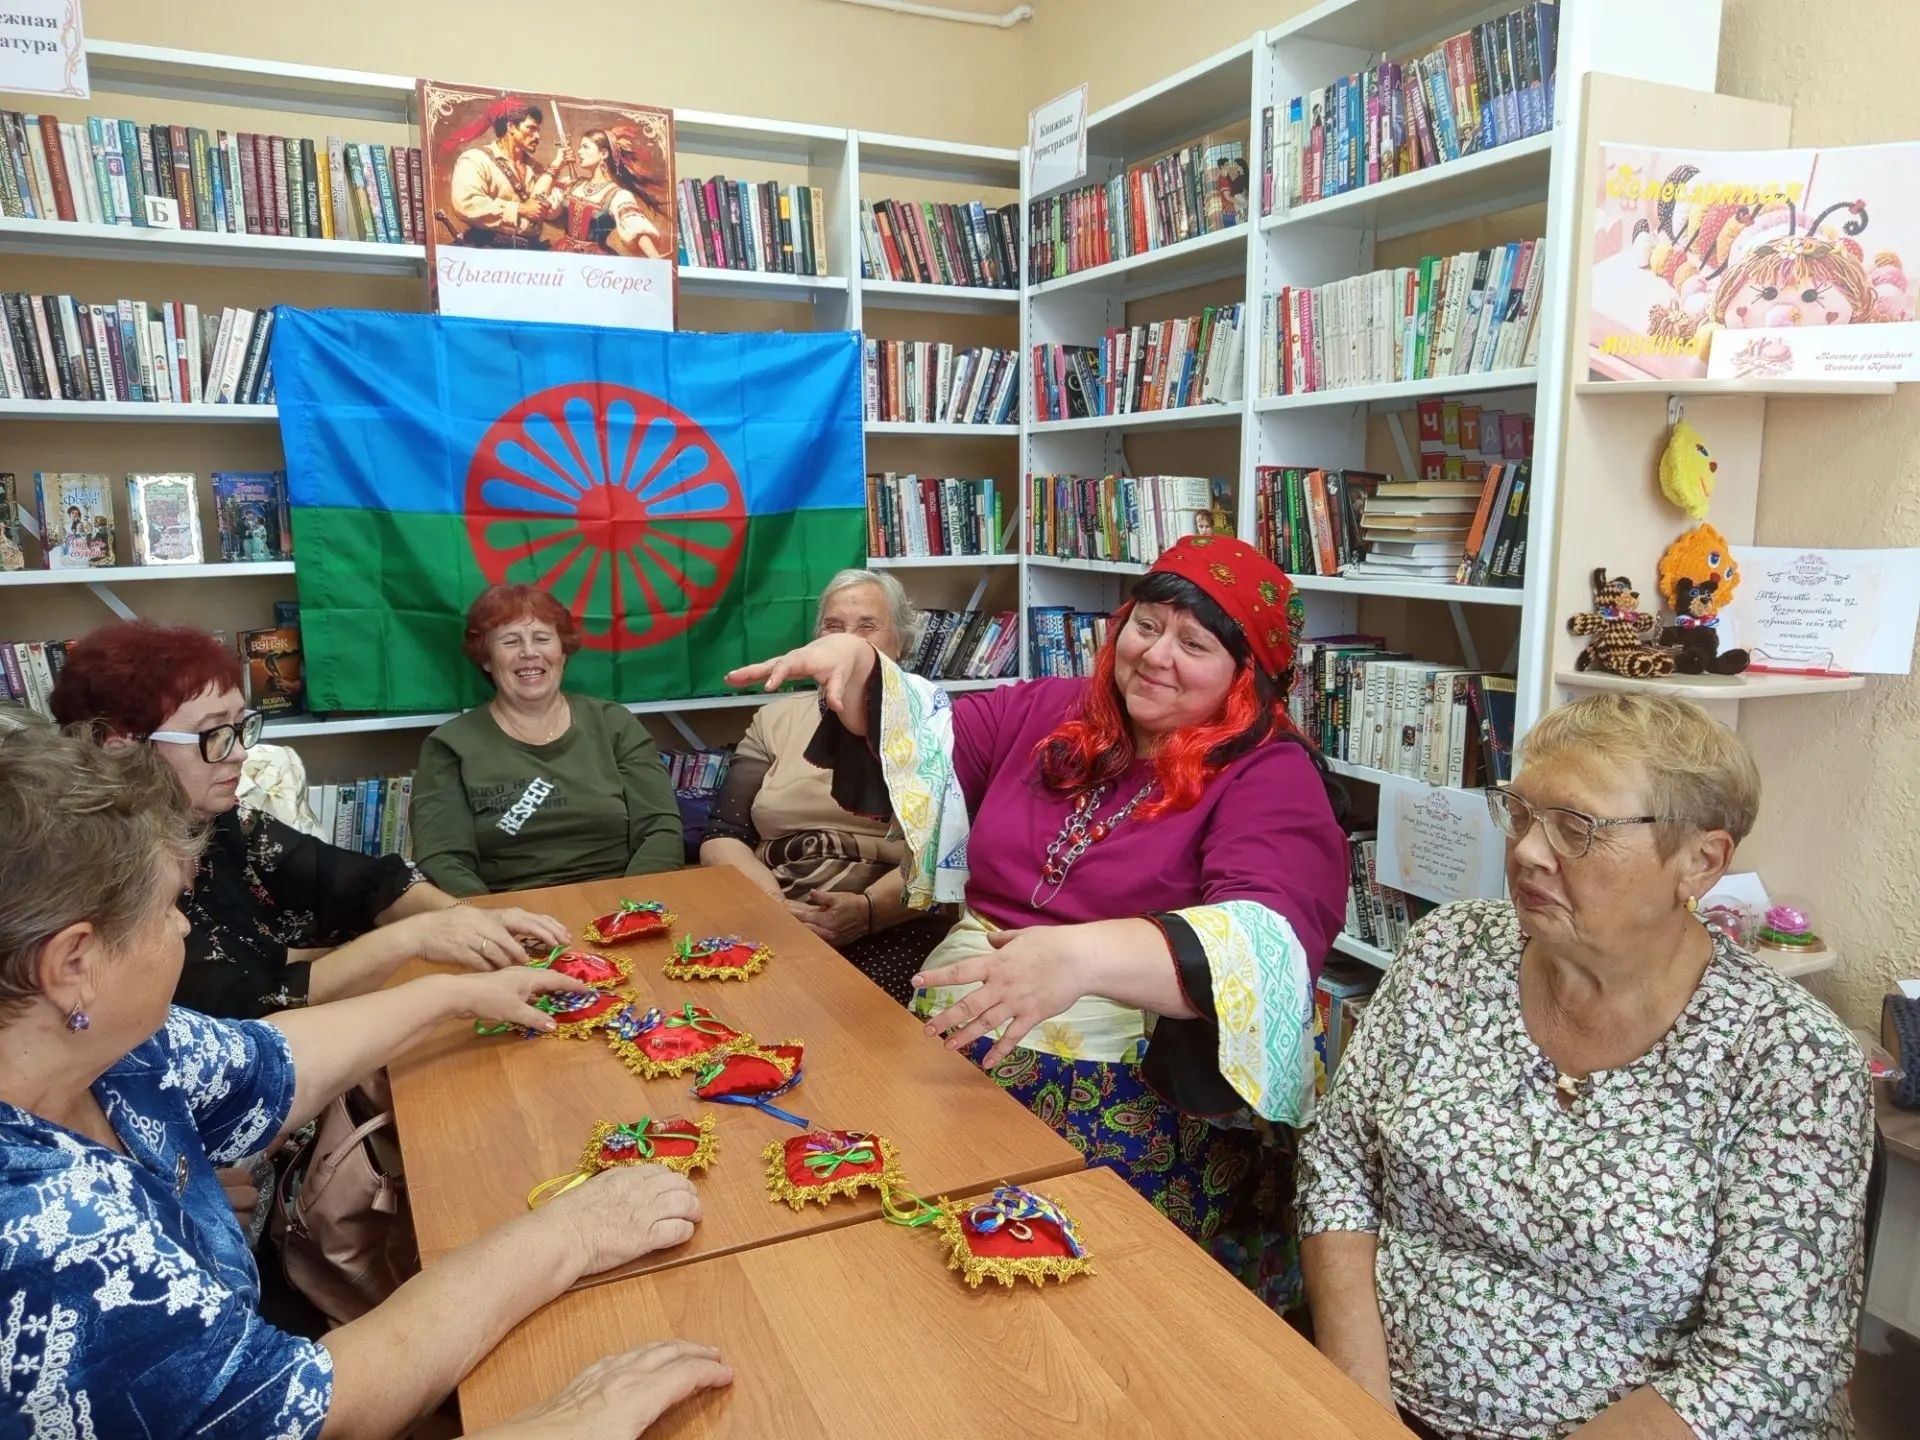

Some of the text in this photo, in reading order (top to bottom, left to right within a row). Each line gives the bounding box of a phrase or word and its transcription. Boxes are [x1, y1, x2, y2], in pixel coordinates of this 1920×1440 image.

[0, 13, 57, 29] жная
[0, 36, 57, 54] атура
[1040, 114, 1074, 138] Книжные
[149, 201, 168, 223] Б
[439, 256, 564, 288] Цыганский
[250, 638, 290, 652] ВЭНЭК
[1435, 678, 1447, 703] РОЙ
[1450, 747, 1462, 773] РОЙ
[495, 776, 555, 836] RESPECT
